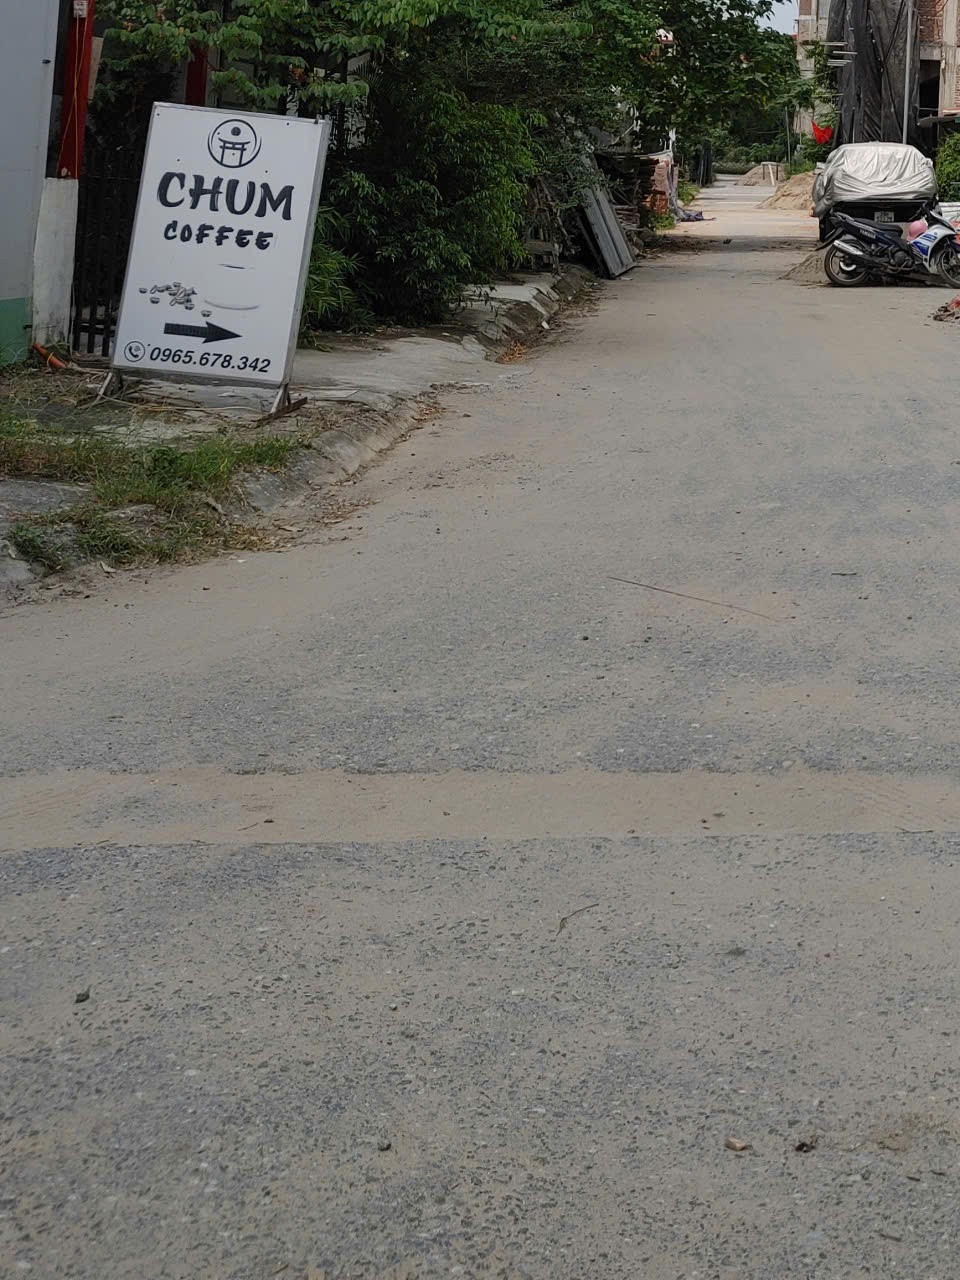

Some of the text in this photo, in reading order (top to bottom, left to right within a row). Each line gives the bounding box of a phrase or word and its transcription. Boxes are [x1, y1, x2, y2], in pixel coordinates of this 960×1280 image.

[157, 171, 295, 221] CHUM
[164, 220, 274, 250] COFFEE
[150, 346, 271, 373] 0965.678.342
